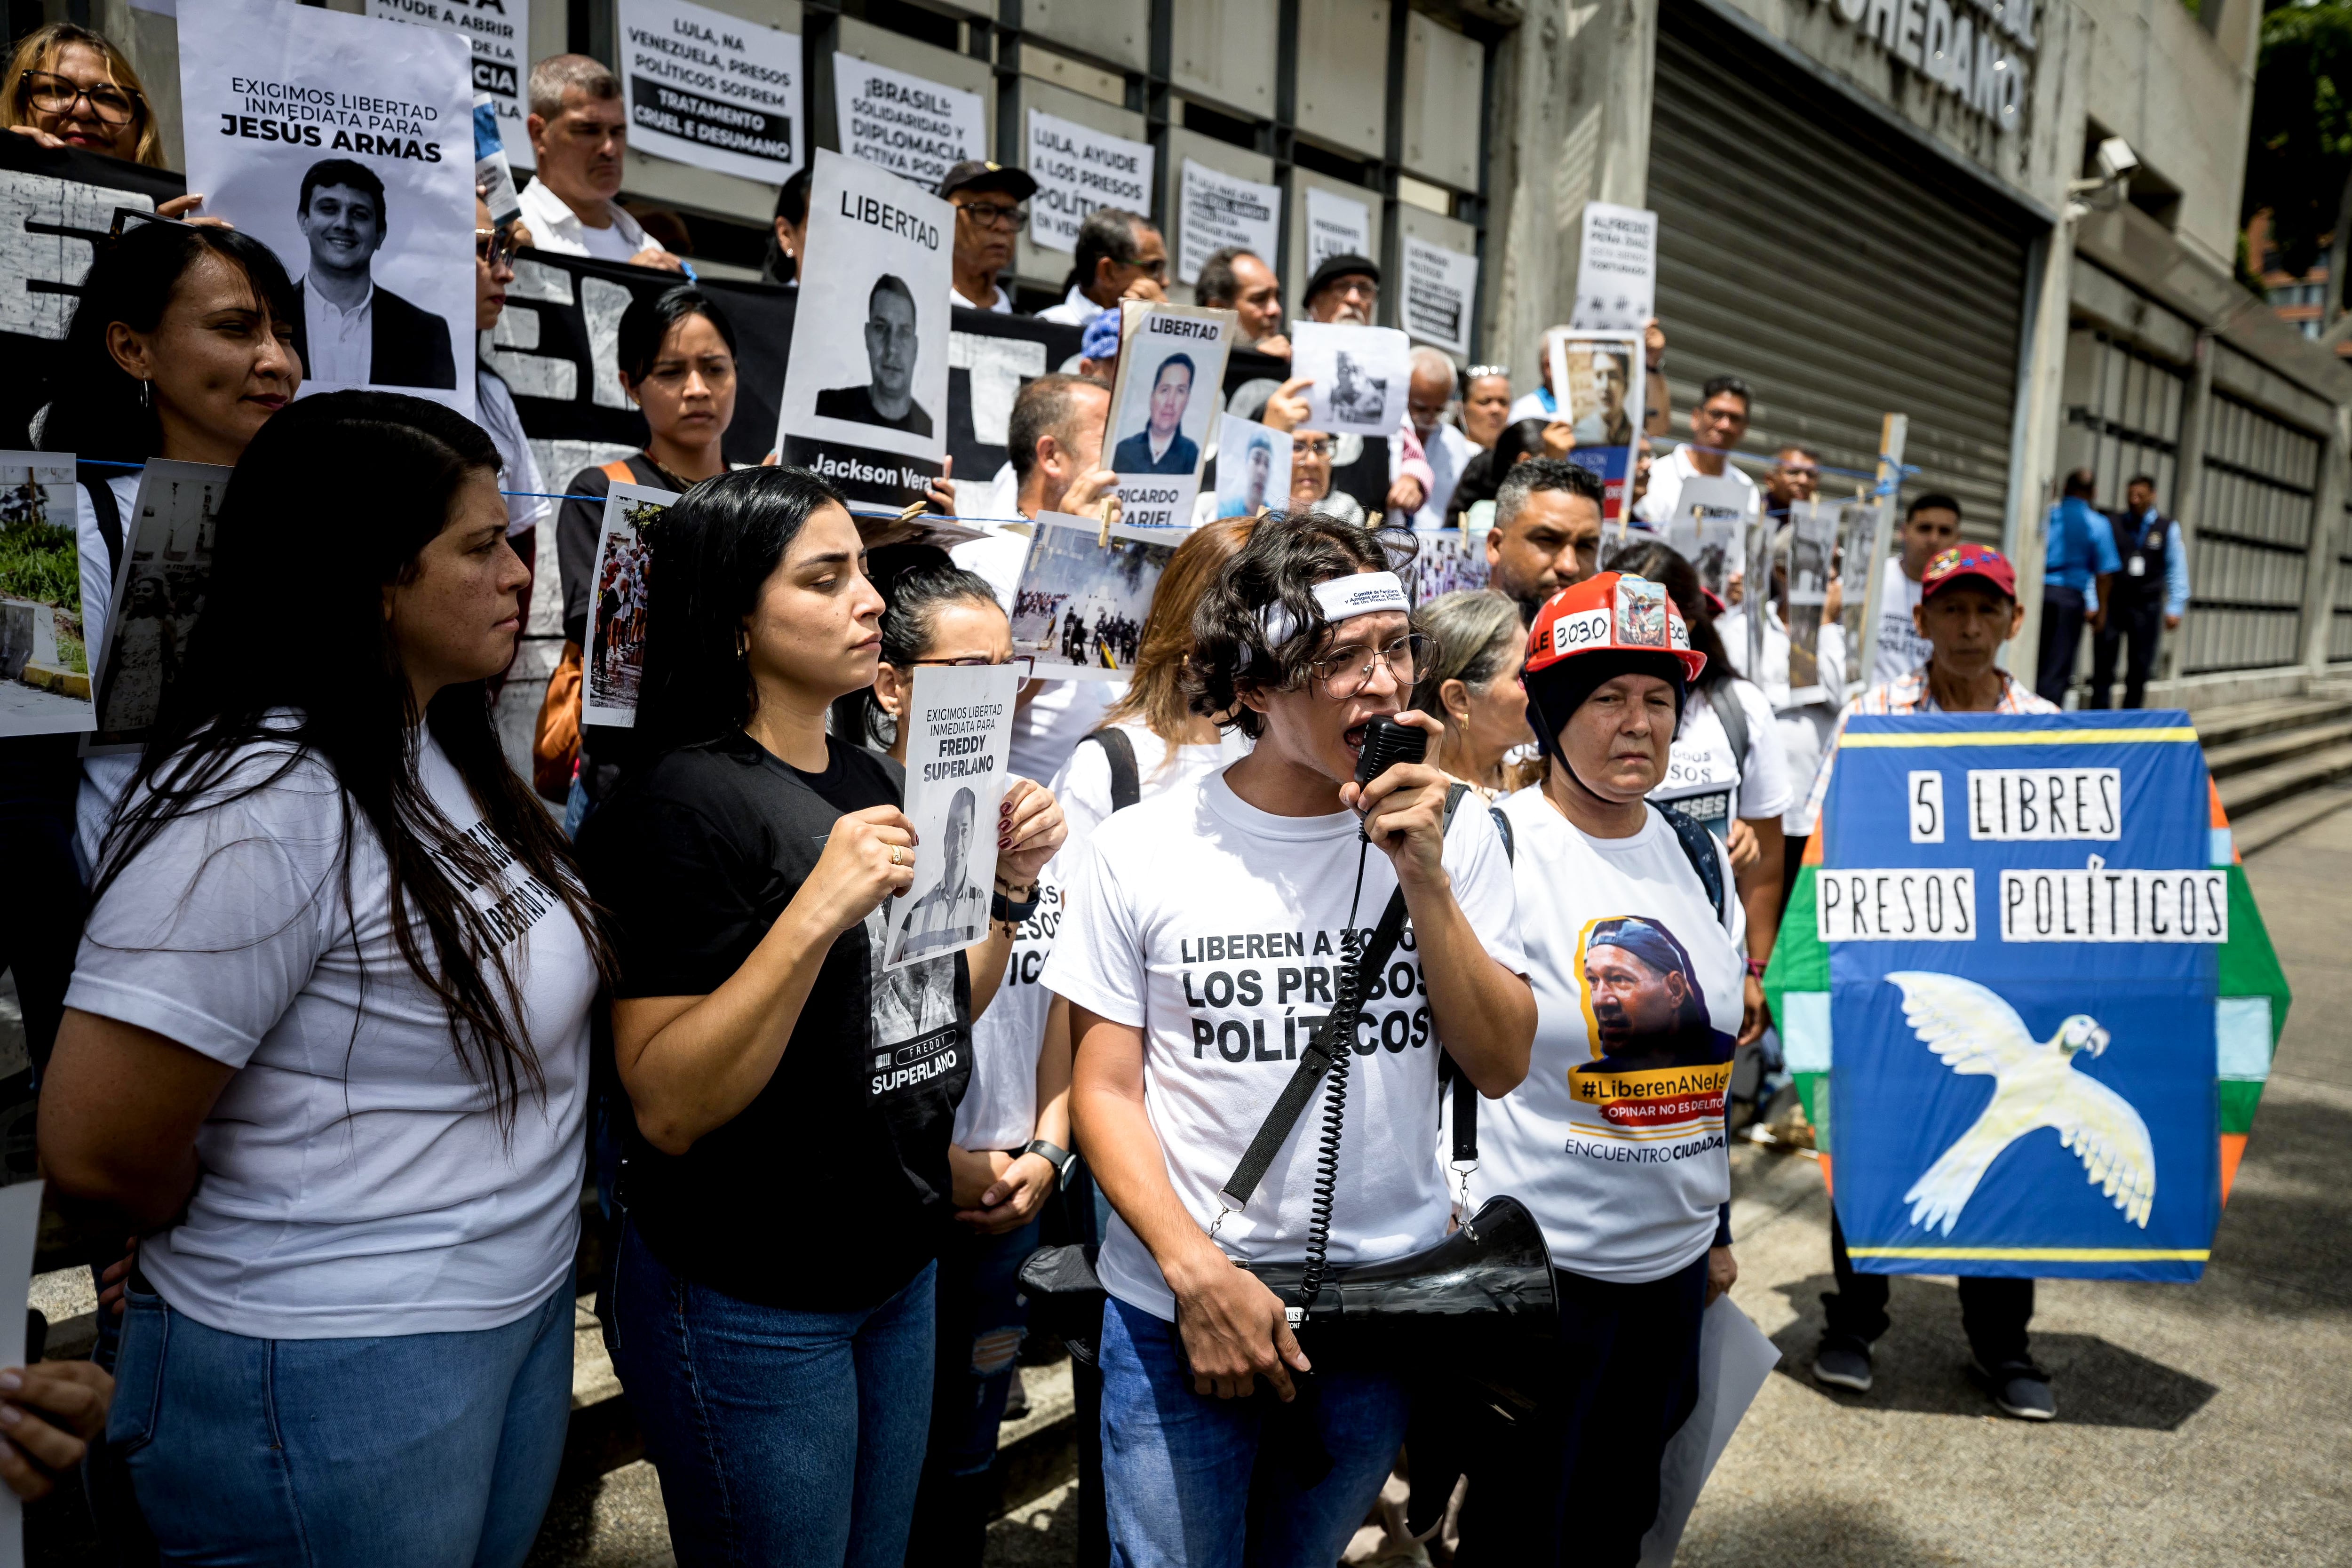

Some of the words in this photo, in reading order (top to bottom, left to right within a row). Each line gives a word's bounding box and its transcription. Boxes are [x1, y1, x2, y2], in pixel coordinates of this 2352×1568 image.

[378, 0, 437, 20] AYUDE
[442, 8, 456, 24] A
[459, 13, 516, 39] ABRIR
[673, 18, 719, 46] LULA,
[722, 33, 745, 52] NA
[471, 39, 493, 55] DE
[495, 46, 516, 59] LA
[628, 26, 724, 71] VENEZUELA,
[729, 58, 791, 87] PRESOS
[232, 77, 334, 106] EXIGIMOS
[342, 94, 437, 121] LIBERTAD
[635, 53, 716, 90] POLÍTICOS
[720, 79, 785, 107] SOFREM
[245, 97, 362, 127] INMEDIATA
[369, 115, 423, 136] PARA
[658, 89, 765, 131] TRATAMENTO
[221, 113, 322, 146] JESÚS
[331, 130, 442, 163] ARMAS
[635, 104, 682, 133] CRUEL
[684, 119, 695, 137] E
[699, 123, 789, 158] DESUMANO
[852, 118, 968, 161] DIPLOMACIA
[1036, 156, 1043, 170] A
[1047, 159, 1076, 182] LOS
[1081, 170, 1143, 200] PRESOS
[1083, 144, 1138, 174] AYUDE
[841, 190, 938, 250] LIBERTAD
[1036, 185, 1108, 218] POLÍTI
[1150, 317, 1218, 340] LIBERTAD
[809, 453, 897, 486] Jackson
[901, 467, 931, 492] Vera
[1118, 489, 1179, 503] RICARDO
[1557, 617, 1607, 648] 3030
[927, 707, 966, 722] EXIGIMOS
[969, 704, 1002, 718] LIBERTAD
[930, 721, 974, 736] INMEDIATA
[977, 719, 994, 732] PARA
[939, 735, 986, 757] FREDDY
[924, 755, 993, 782] SUPERLANO
[1916, 780, 1936, 835] 5
[1976, 775, 2115, 834] LIBRES
[1824, 877, 1969, 933] PRESOS
[2008, 861, 2222, 936] POLÍTICOS
[1181, 932, 1304, 963] LIBEREN
[1313, 931, 1334, 955] A
[1183, 970, 1263, 1008] LOS
[910, 1036, 945, 1058] FREDDY
[1192, 1006, 1429, 1063] POLÍTCOS
[872, 1050, 957, 1095] SUPERLANO
[1608, 1106, 1656, 1118] OPINAR
[1660, 1104, 1676, 1115] NO
[1678, 1102, 1690, 1114] ES
